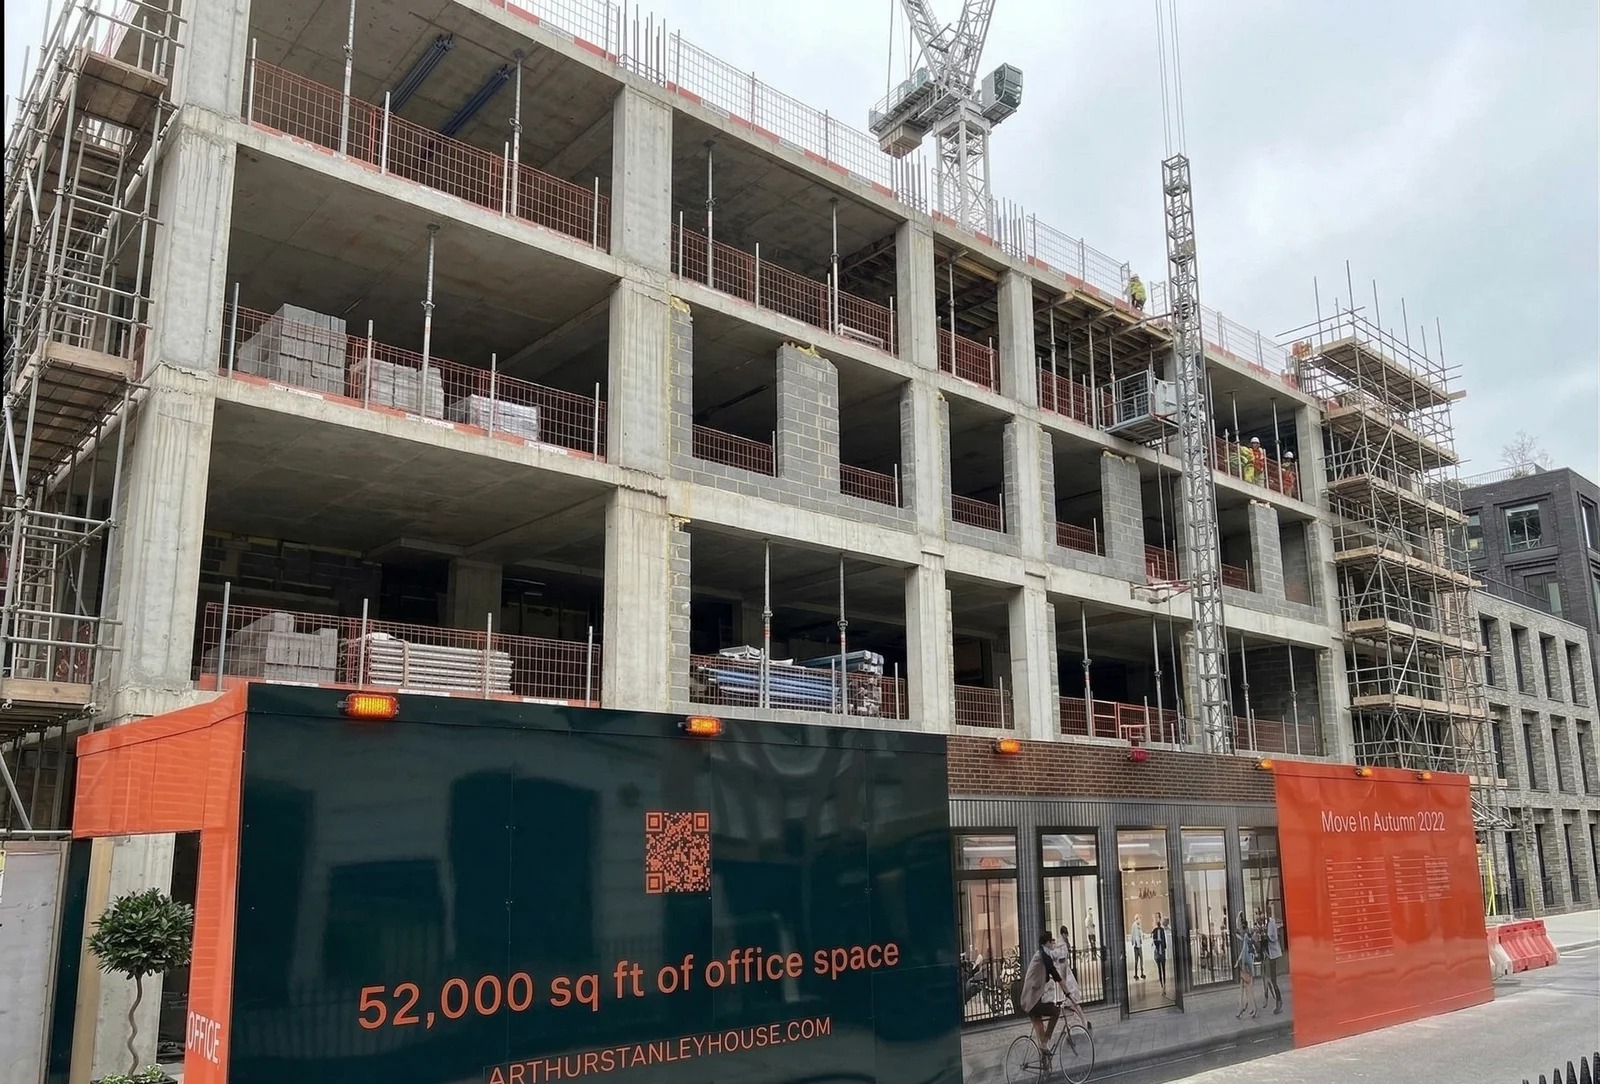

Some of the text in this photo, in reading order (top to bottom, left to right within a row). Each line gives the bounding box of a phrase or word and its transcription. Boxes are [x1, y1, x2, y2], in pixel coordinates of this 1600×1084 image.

[1321, 810, 1446, 833] Move In Autumn 2022
[358, 942, 900, 1030] 52,000 sq ft of office space
[489, 1016, 832, 1084] ARTHURSTANLEYHOUSE.COM
